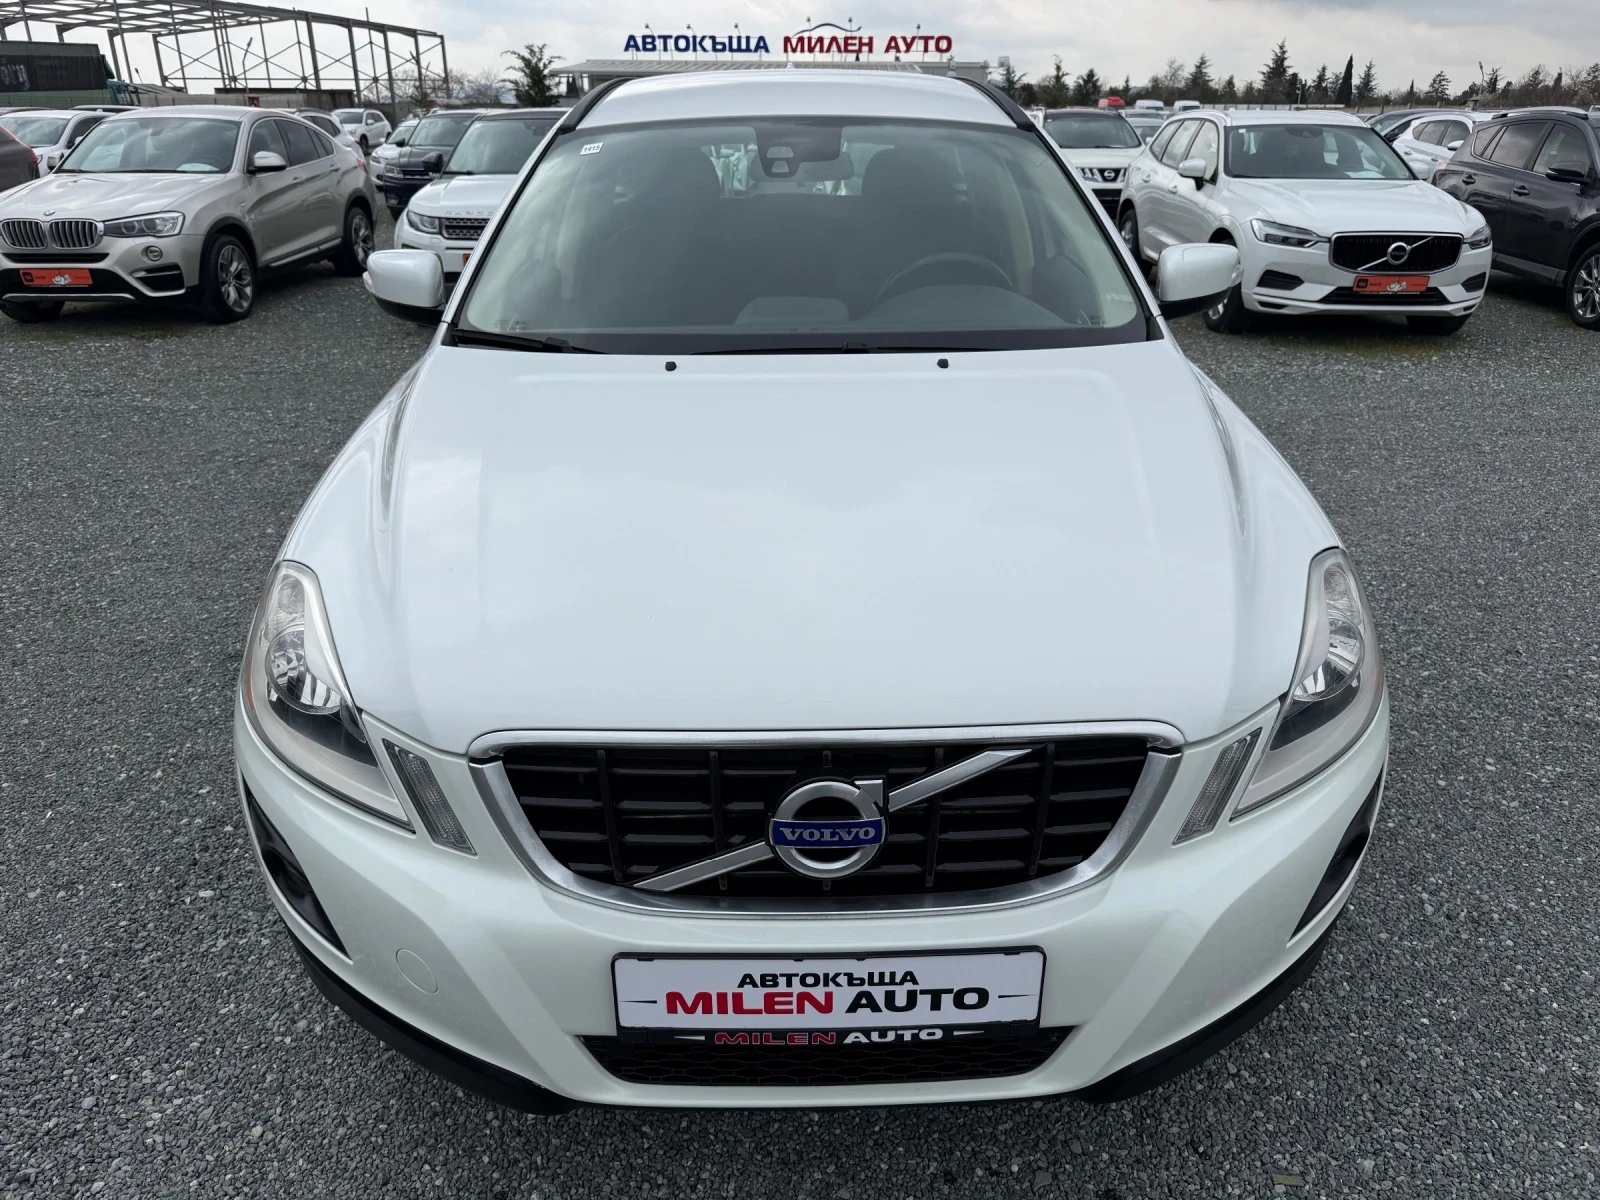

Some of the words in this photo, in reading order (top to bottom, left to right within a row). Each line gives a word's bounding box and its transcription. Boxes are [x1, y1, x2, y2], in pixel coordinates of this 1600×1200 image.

[783, 36, 873, 53] МИЛЕН
[884, 36, 952, 53] АУТО
[779, 826, 876, 842] VOLVO
[665, 991, 833, 1015] MILEN
[844, 987, 990, 1014] AUTO
[714, 1032, 837, 1046] MILEN
[842, 1028, 944, 1044] AUTO
